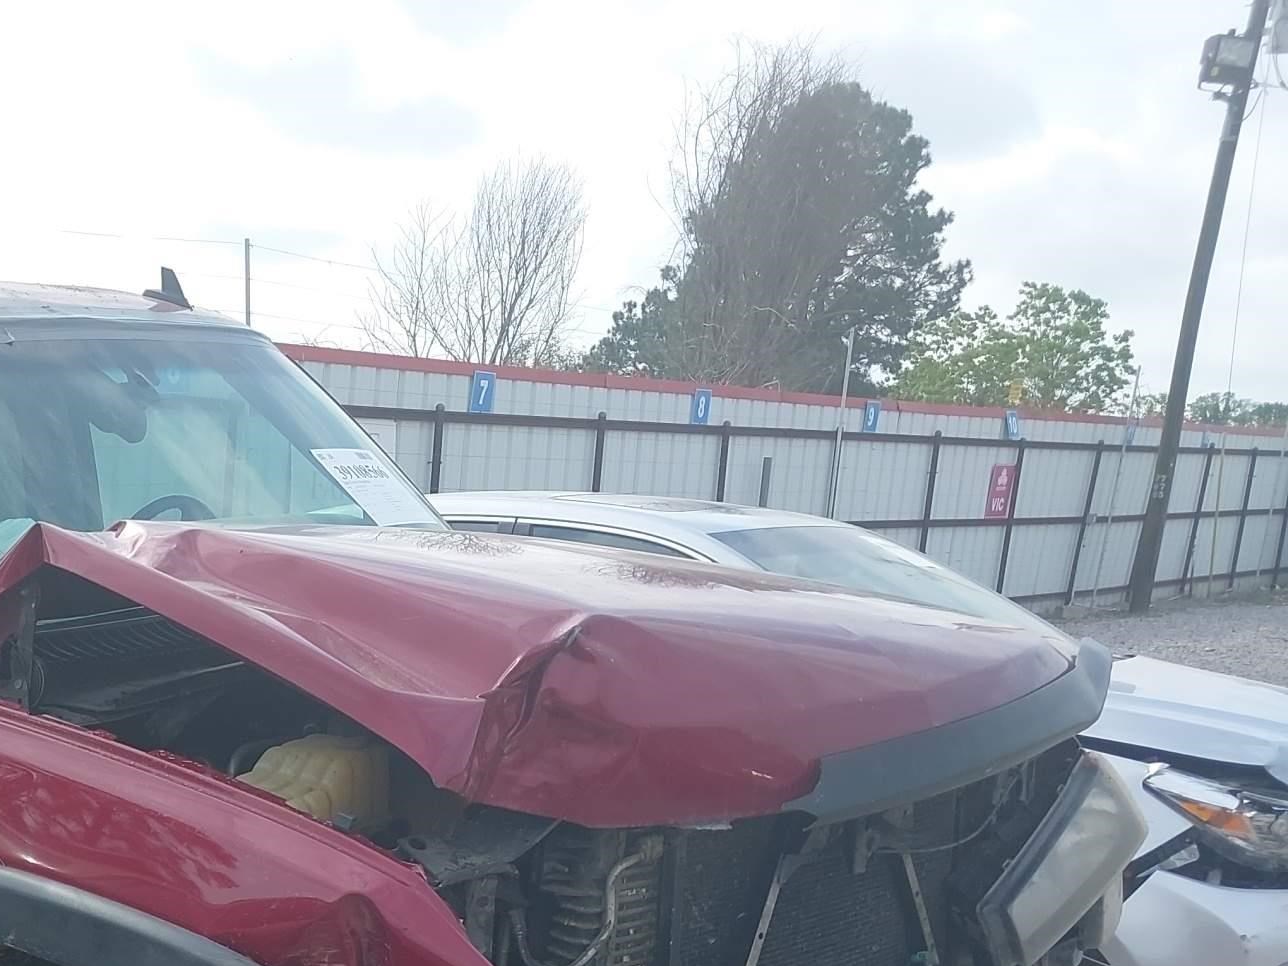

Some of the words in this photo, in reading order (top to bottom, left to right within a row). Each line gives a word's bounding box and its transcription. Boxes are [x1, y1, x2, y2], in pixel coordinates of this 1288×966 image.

[479, 380, 489, 405] 7
[697, 397, 706, 418] 8
[867, 409, 875, 427] 9
[1008, 416, 1017, 433] 10
[991, 498, 1005, 512] VIC
